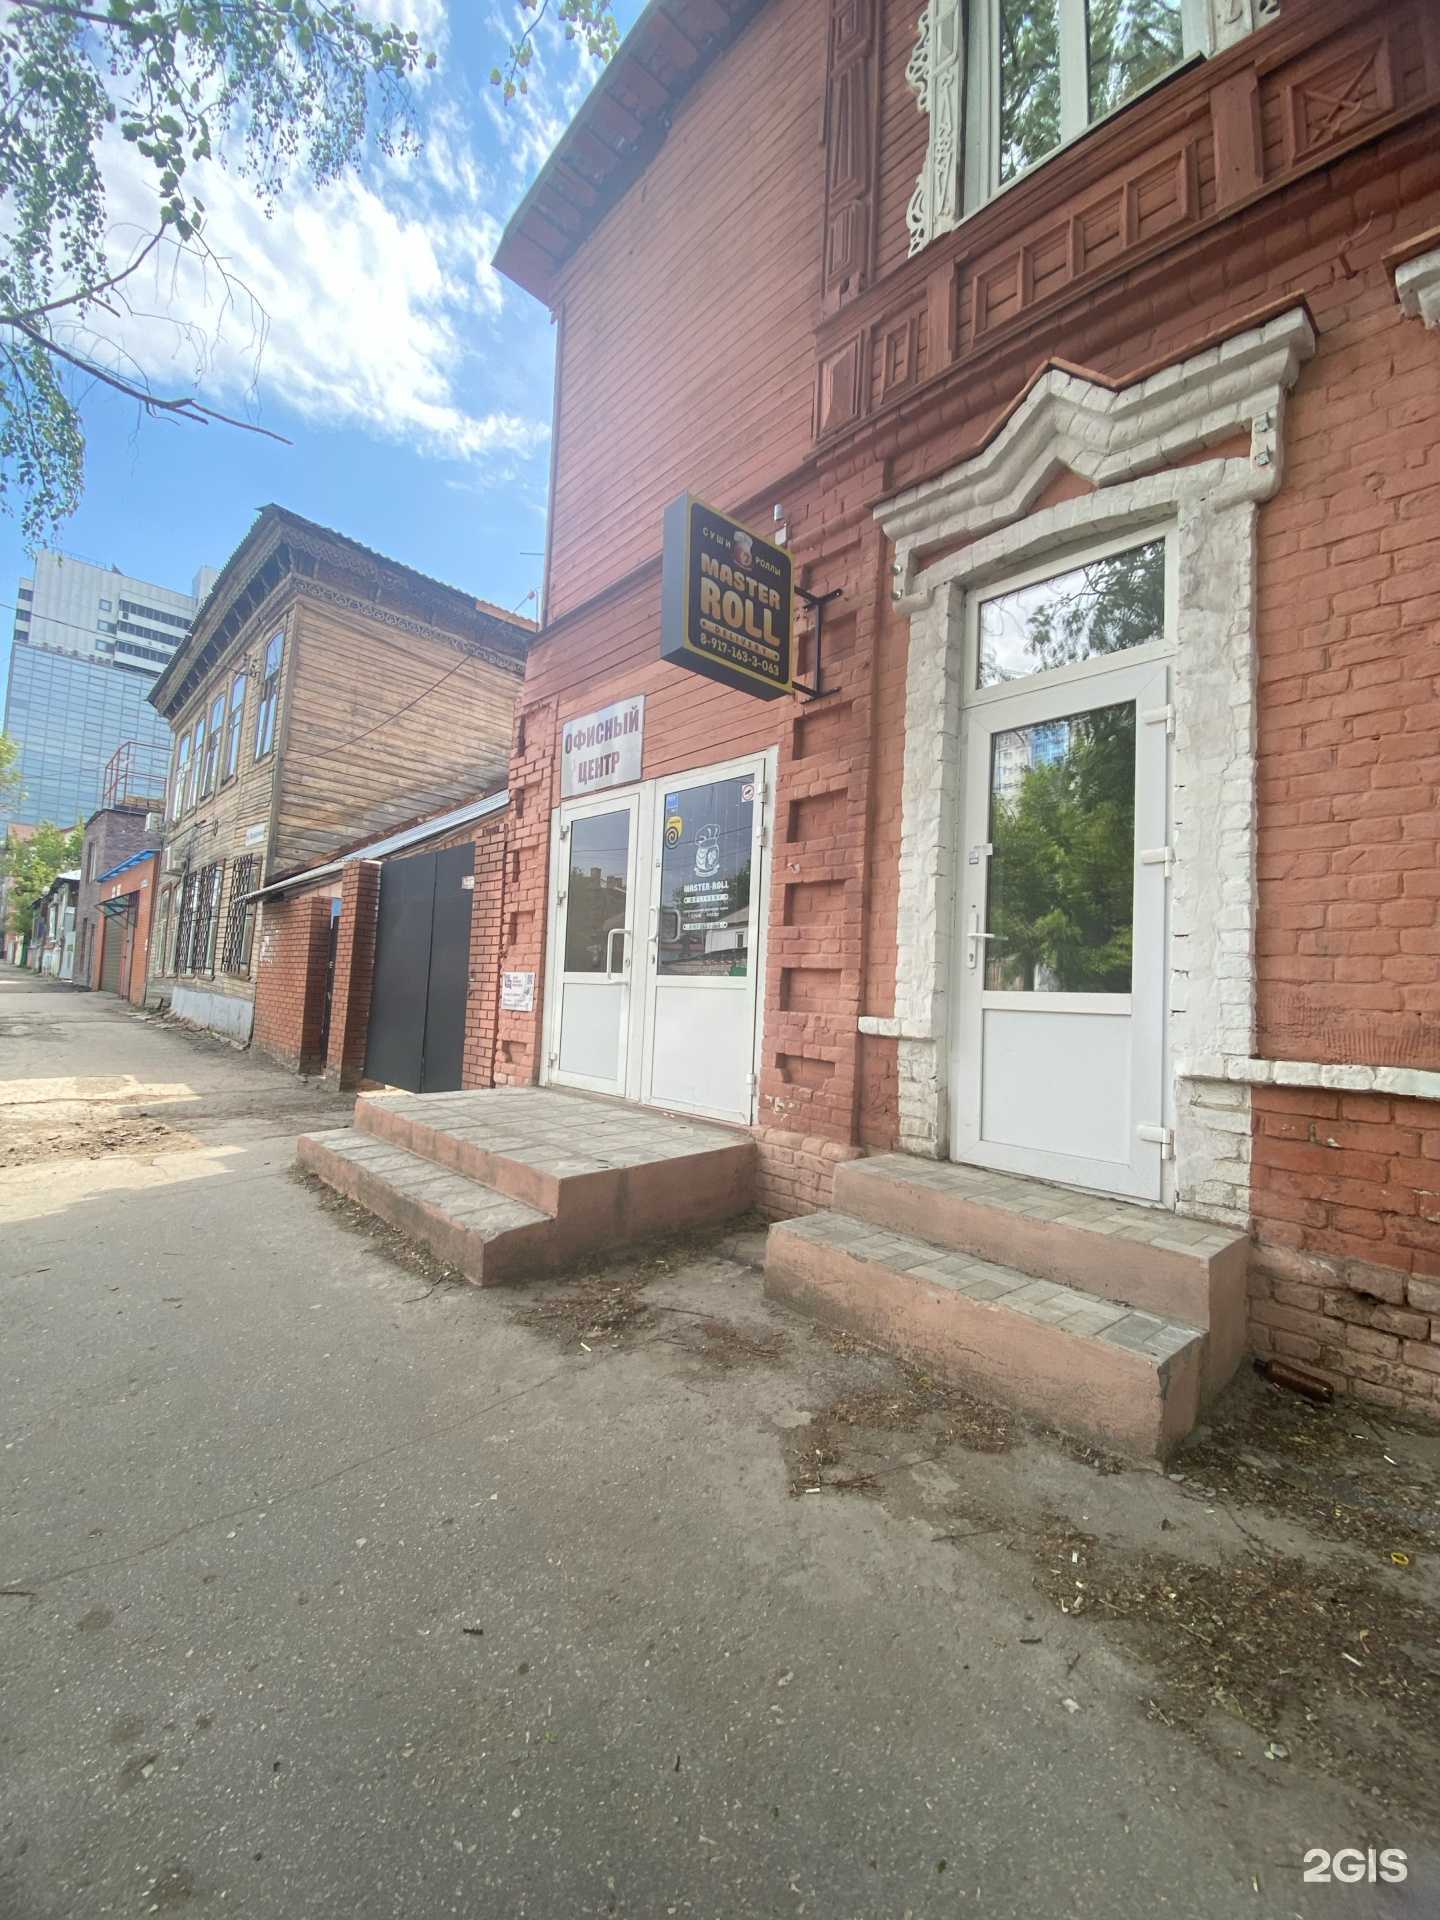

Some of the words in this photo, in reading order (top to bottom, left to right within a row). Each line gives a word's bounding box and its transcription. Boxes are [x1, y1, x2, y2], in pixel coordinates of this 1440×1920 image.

[701, 552, 781, 610] MASTER
[701, 576, 781, 647] ROLL
[565, 705, 639, 754] ОФИСНЫЙ
[578, 751, 620, 785] ЦЕНТР
